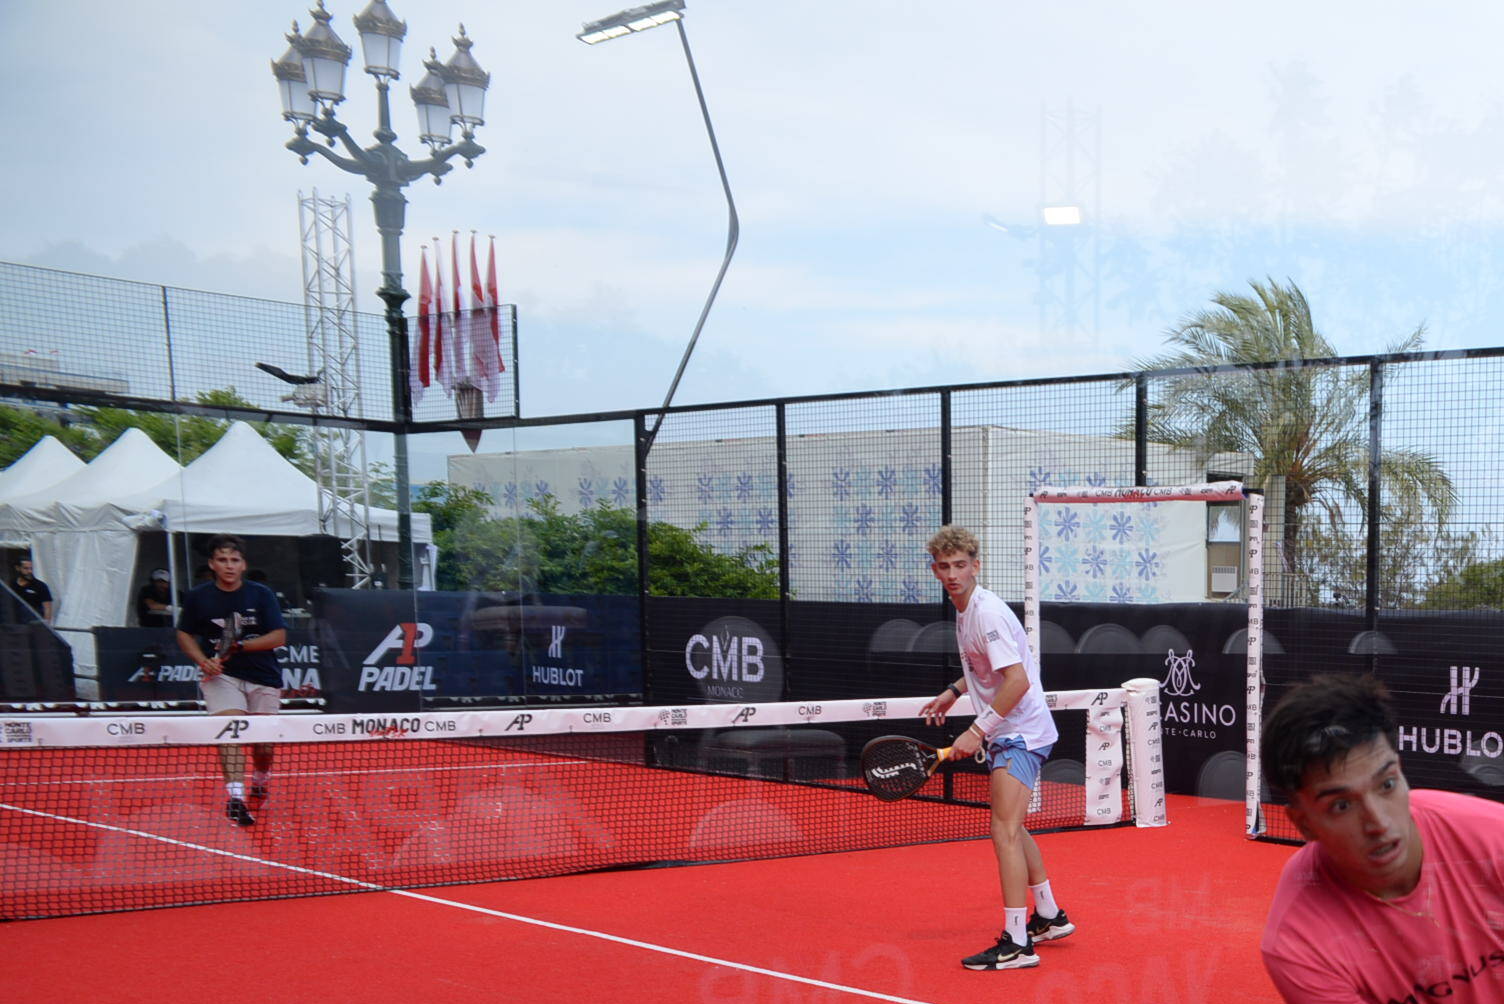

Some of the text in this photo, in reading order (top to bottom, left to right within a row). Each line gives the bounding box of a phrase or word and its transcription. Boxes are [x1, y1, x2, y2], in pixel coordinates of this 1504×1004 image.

[685, 633, 764, 682] CMB
[358, 666, 436, 692] PADEL
[532, 665, 584, 688] HUBLOT
[583, 712, 611, 723] CMB
[798, 705, 822, 716] CMB
[1160, 701, 1236, 726] ASINO
[106, 722, 145, 735] CMB
[313, 722, 346, 735] CMB
[351, 717, 421, 735] MONACO
[424, 720, 456, 732] CMB
